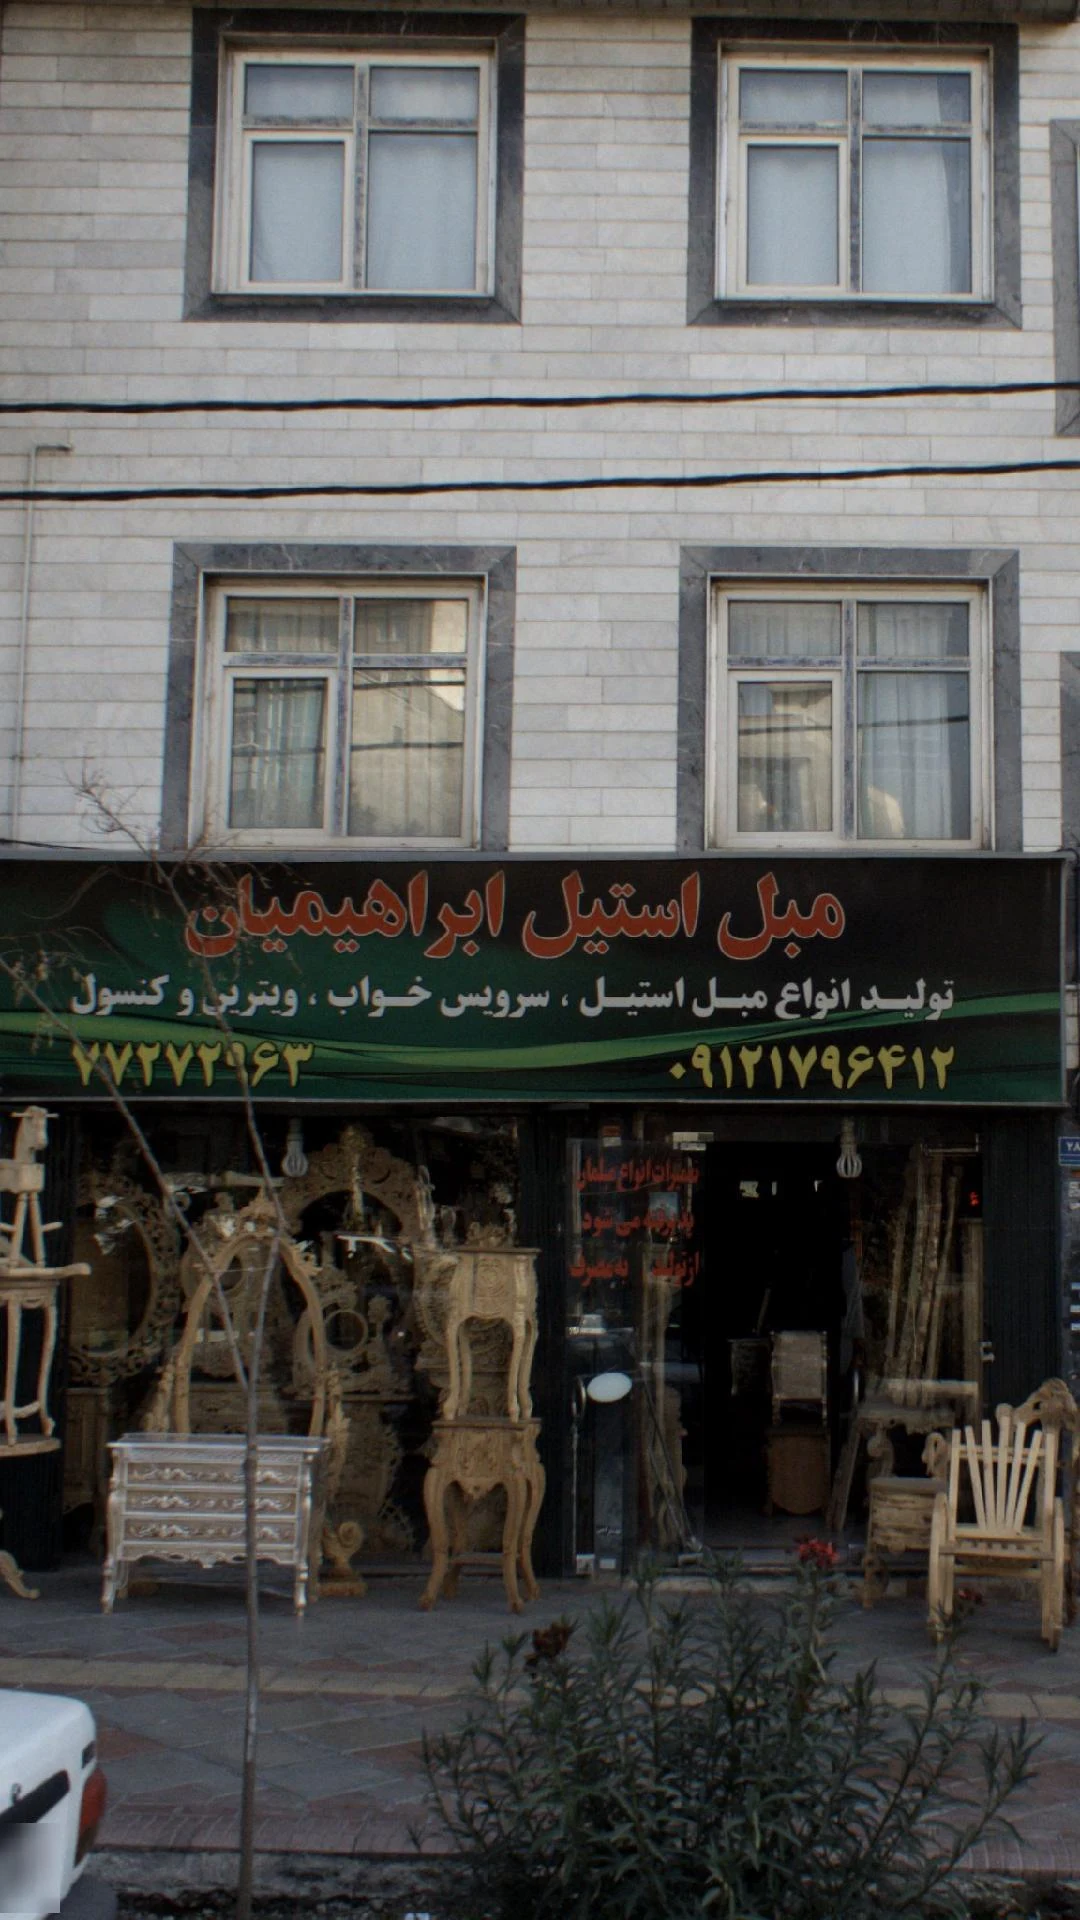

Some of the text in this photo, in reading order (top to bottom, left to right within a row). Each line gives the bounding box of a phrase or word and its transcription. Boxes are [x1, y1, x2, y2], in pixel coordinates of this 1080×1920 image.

[184, 868, 847, 961] مبل استیل ابراهیمیان
[70, 972, 171, 1016] کنسول
[175, 987, 195, 1017] و
[201, 979, 299, 1017] ویترین
[327, 974, 433, 1018] خواب
[440, 984, 550, 1018] سرویس
[579, 975, 685, 1018] استیل
[691, 976, 768, 1019] مبل
[774, 977, 850, 1021] انواع
[860, 977, 955, 1021] تولید
[669, 1043, 955, 1090] ۰۹۱۲۱۷۹۶۴۱۲
